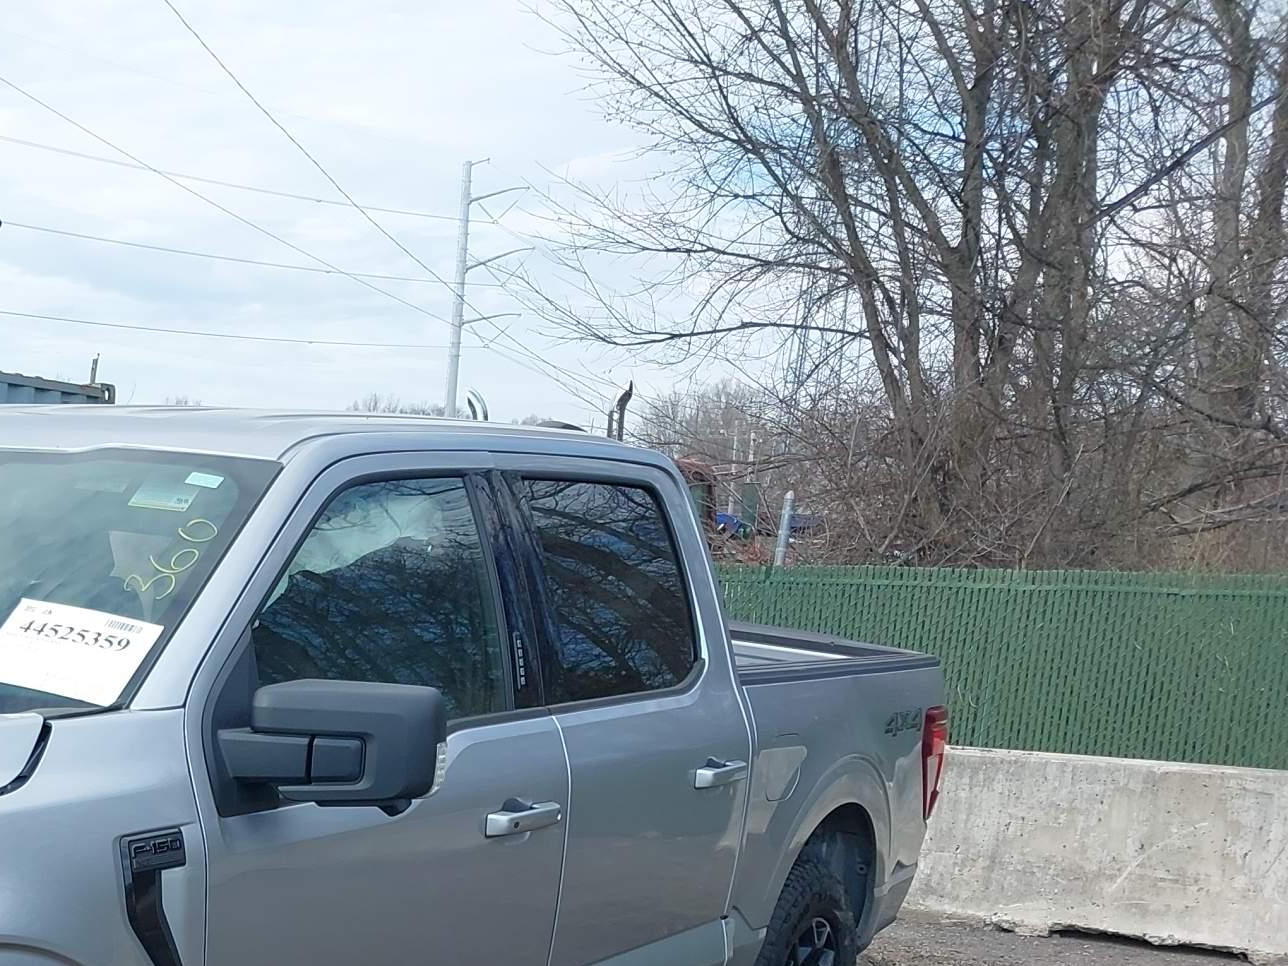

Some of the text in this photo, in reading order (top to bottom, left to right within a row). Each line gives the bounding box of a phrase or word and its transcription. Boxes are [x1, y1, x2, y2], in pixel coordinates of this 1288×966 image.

[123, 518, 218, 600] 360
[19, 619, 131, 652] 44525359
[131, 837, 181, 858] F-150
